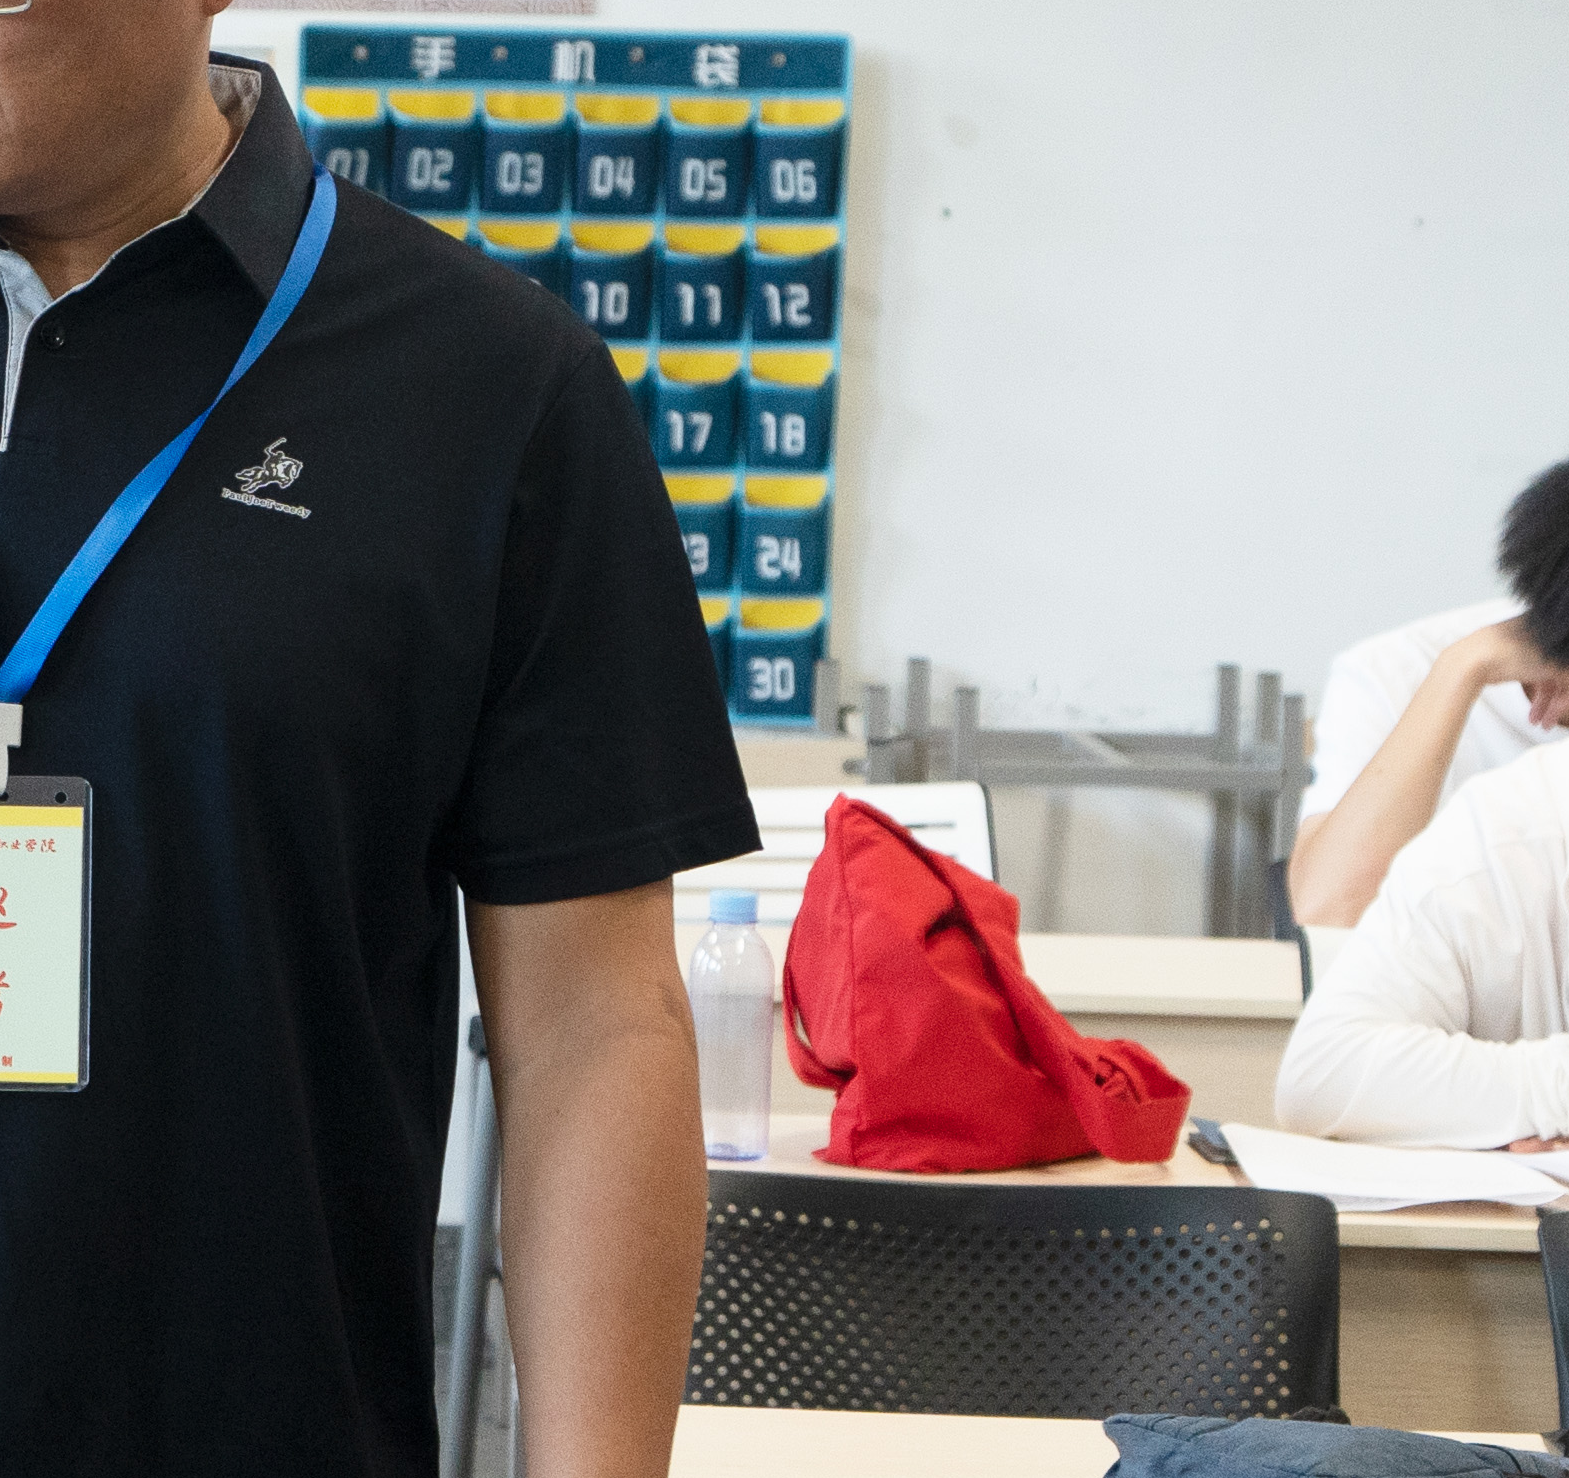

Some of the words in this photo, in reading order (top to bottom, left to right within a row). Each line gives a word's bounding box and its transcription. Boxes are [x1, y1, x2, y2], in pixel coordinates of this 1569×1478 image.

[407, 147, 455, 191] 02
[497, 151, 544, 194] 03
[589, 155, 636, 199] 04
[680, 158, 728, 202] 05
[771, 159, 818, 203] 06
[583, 280, 630, 324] 10
[677, 283, 723, 325] 11
[764, 283, 812, 326] 12
[667, 410, 714, 453] 17
[761, 411, 807, 456] 18
[681, 532, 710, 576] 3
[756, 535, 803, 580] 24
[749, 657, 797, 701] 30
